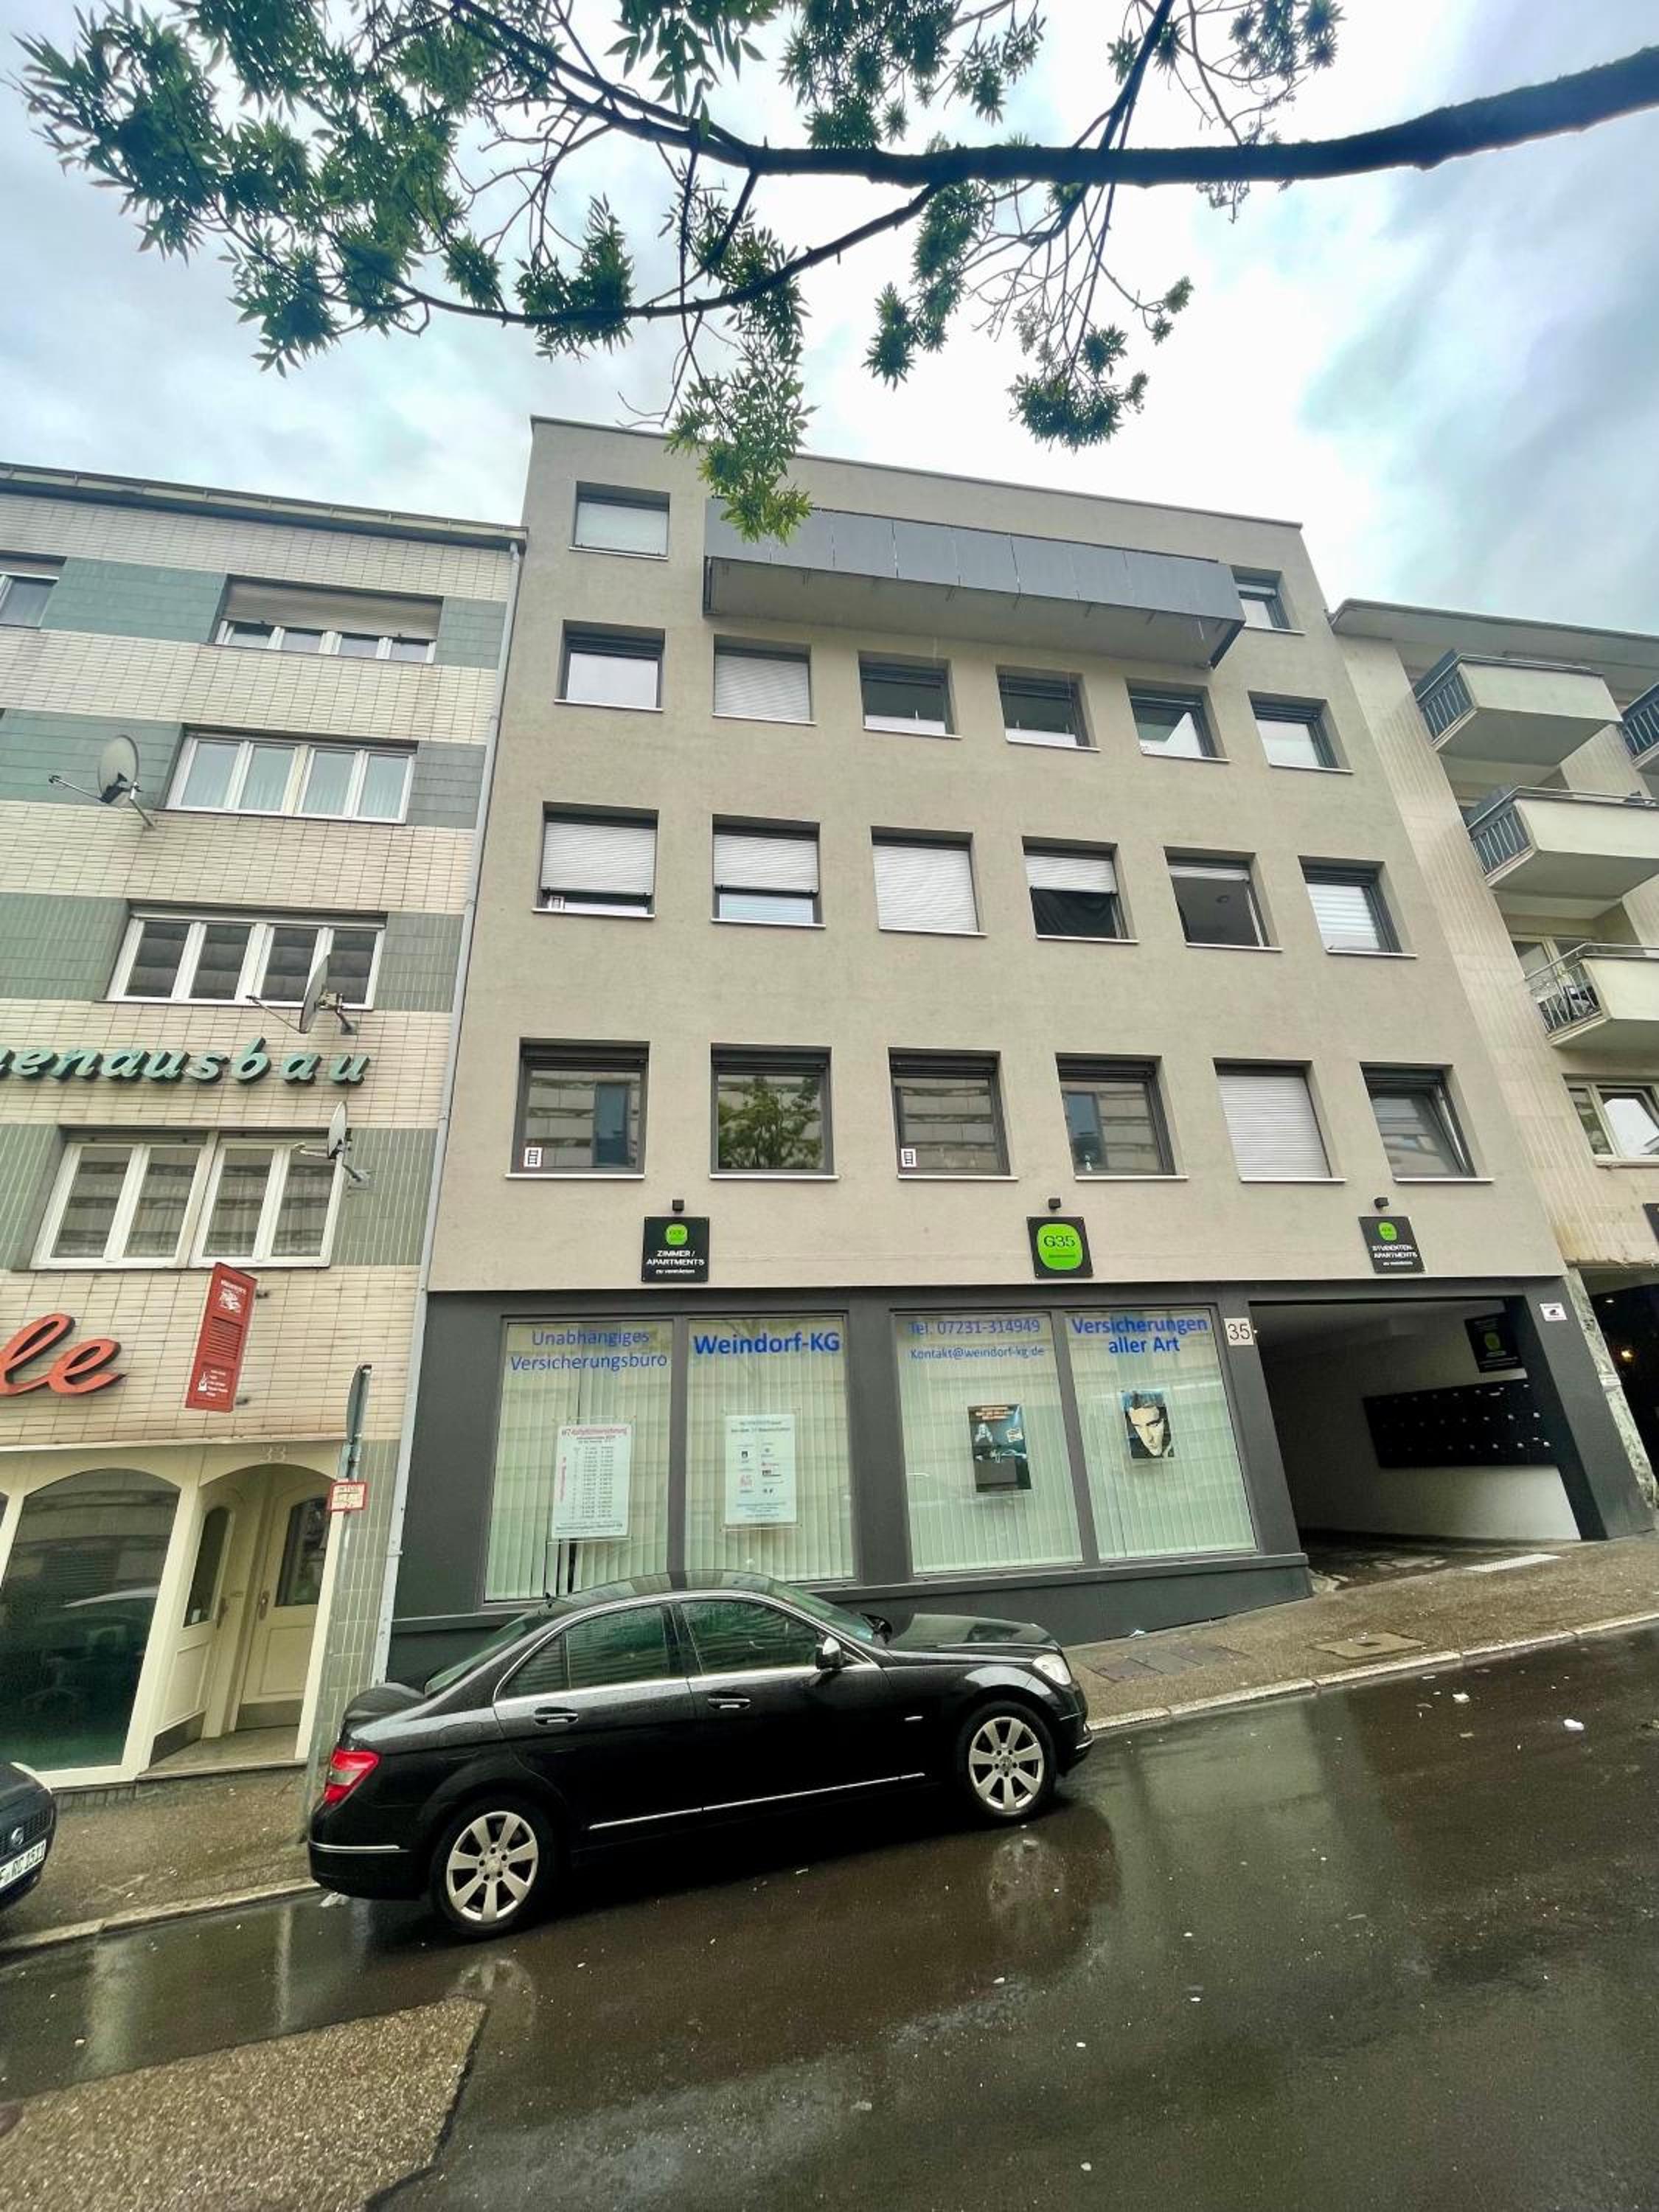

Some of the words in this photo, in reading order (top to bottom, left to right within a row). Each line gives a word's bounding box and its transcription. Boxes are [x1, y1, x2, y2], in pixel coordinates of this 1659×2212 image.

[1043, 1235, 1076, 1247] G35
[937, 1318, 1040, 1335] 07231-314949
[1071, 1315, 1208, 1335] Versicherungen
[1228, 1324, 1251, 1340] 35
[692, 1331, 841, 1354] Weindorf-KG
[1108, 1336, 1147, 1354] aller
[1153, 1336, 1180, 1352] Art
